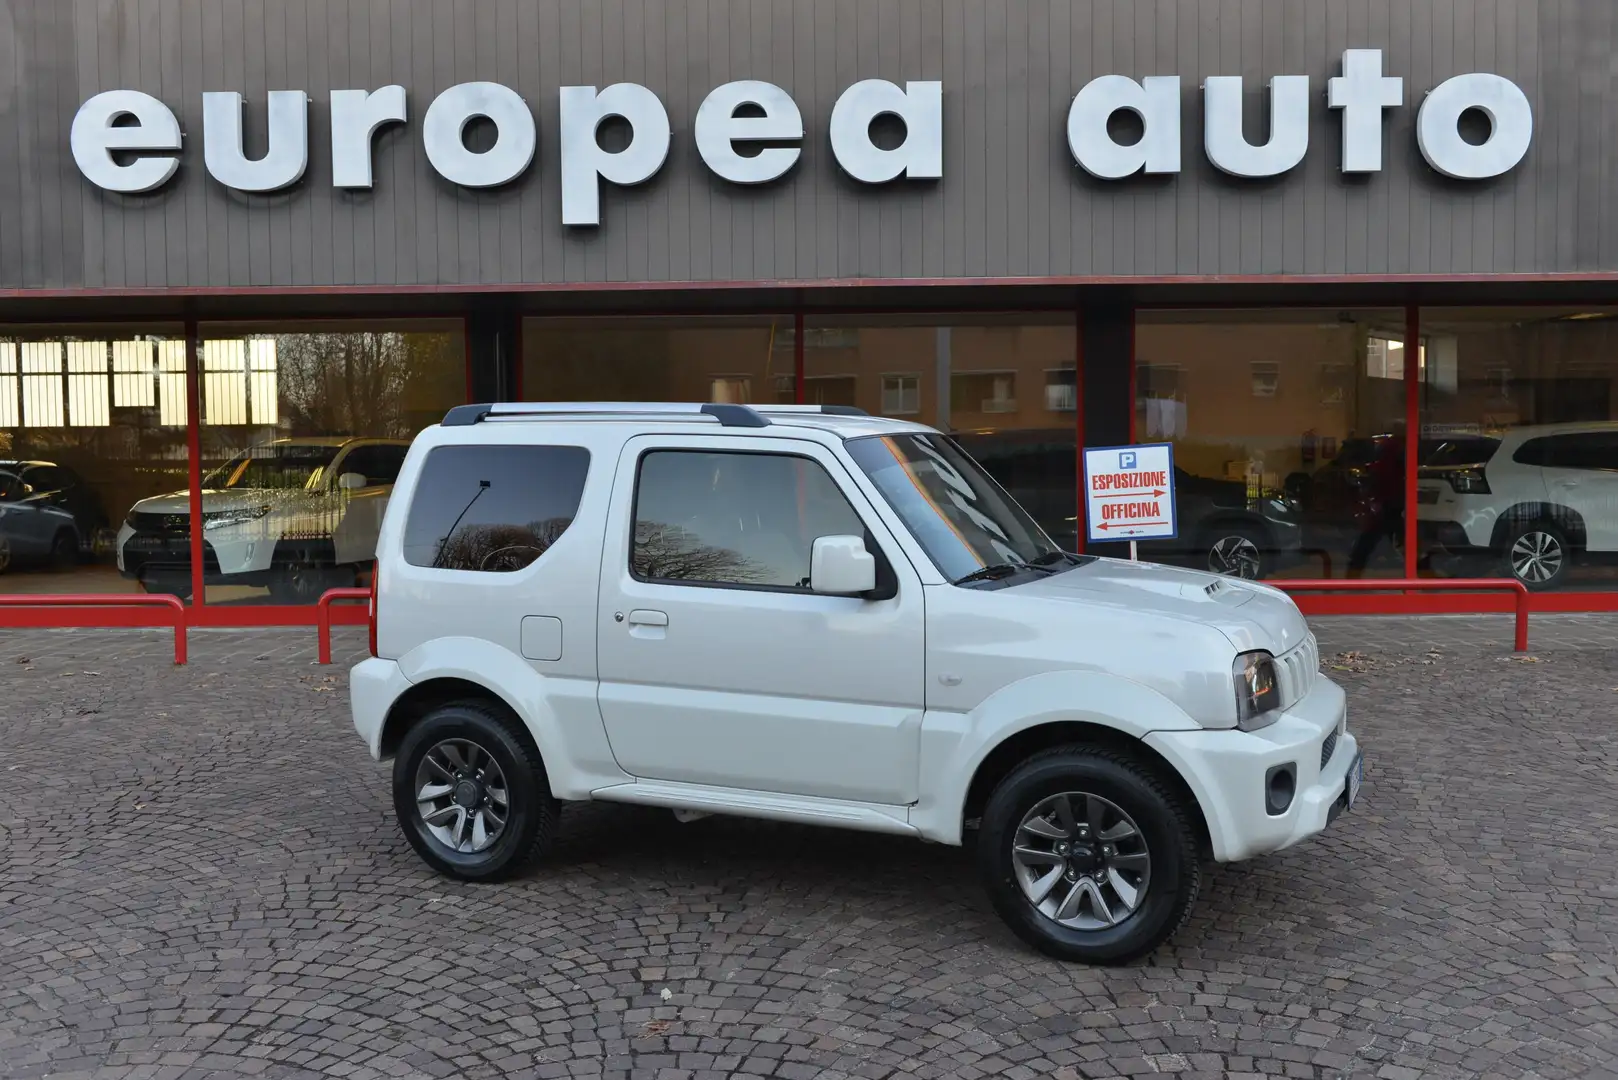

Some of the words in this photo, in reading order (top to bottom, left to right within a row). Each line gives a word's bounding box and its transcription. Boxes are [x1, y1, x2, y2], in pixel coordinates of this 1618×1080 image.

[71, 80, 943, 227] europea
[1067, 48, 1533, 179] auto
[1121, 454, 1134, 468] P
[1092, 471, 1167, 490] ESPOSIZIONE
[1102, 502, 1161, 520] OFFICINA
